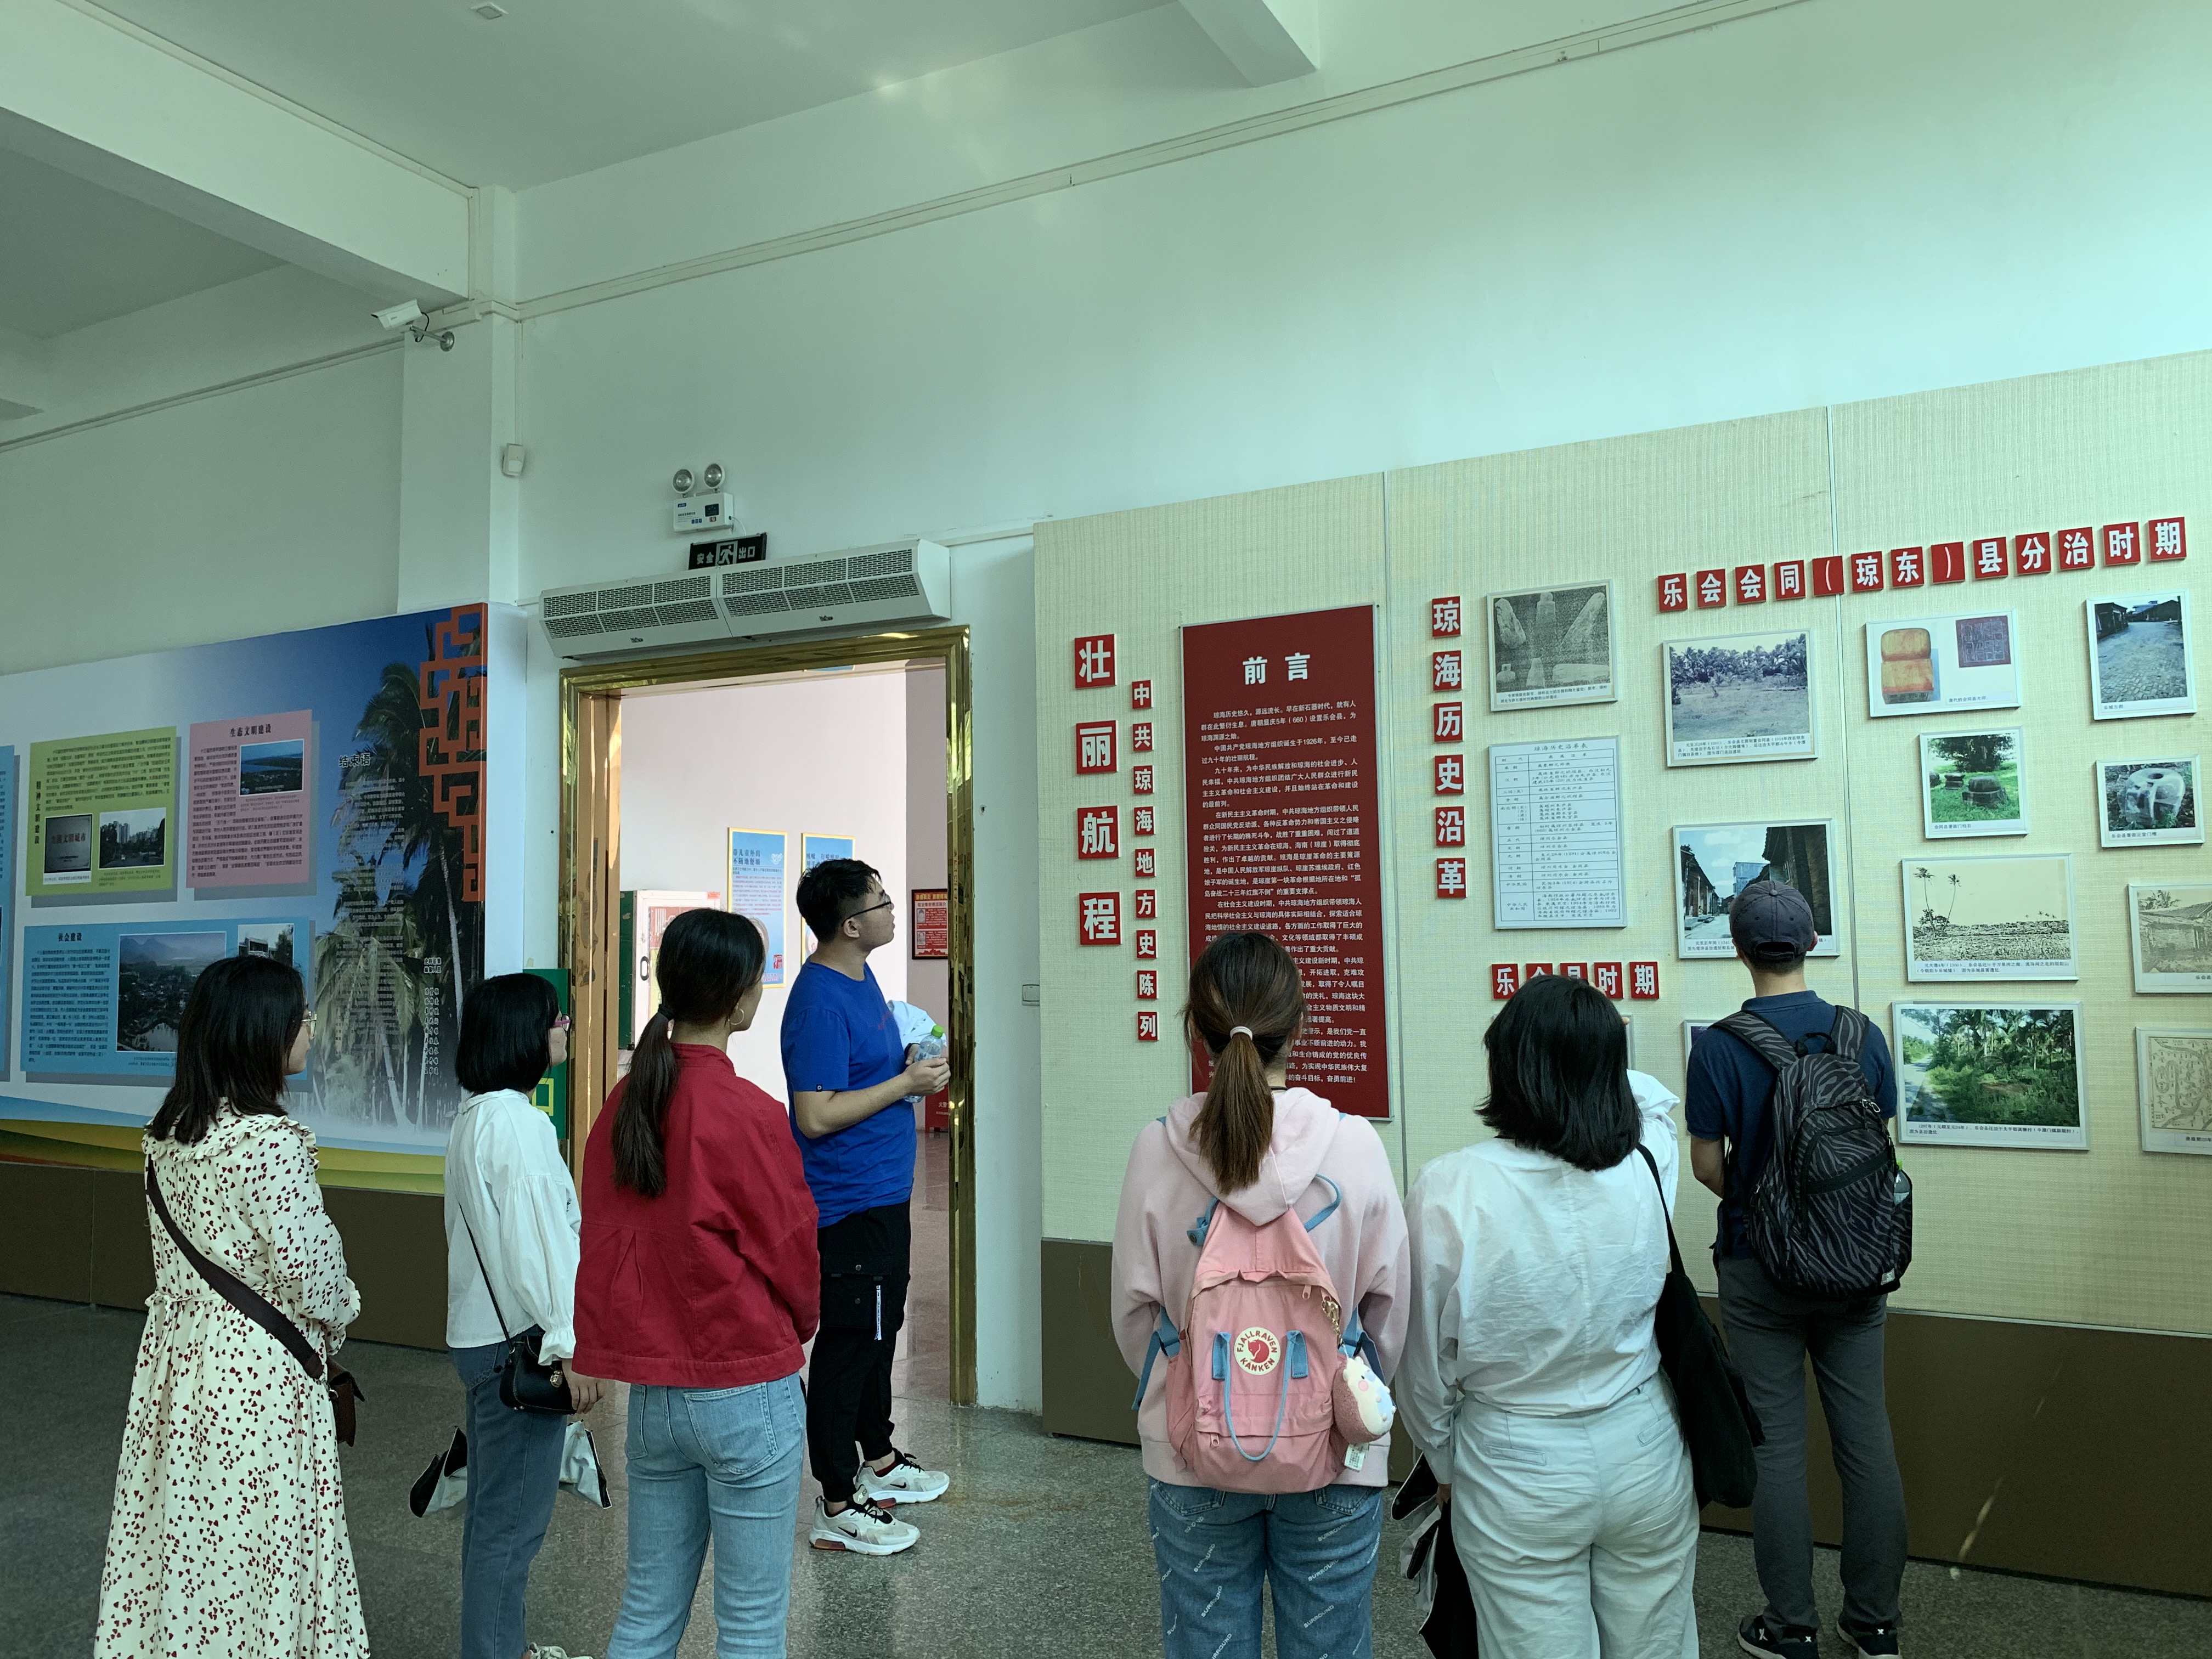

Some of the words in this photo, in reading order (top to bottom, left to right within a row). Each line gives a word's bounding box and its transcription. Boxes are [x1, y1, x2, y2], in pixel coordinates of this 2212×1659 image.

[696, 551, 714, 565] 安全
[738, 546, 755, 560] 出口
[1243, 652, 1311, 685] 前言
[230, 724, 272, 737] 生态文明建设
[1434, 600, 1465, 894] 琼海历史沿革
[338, 753, 371, 768] 结束语
[1079, 640, 1117, 940] 壮丽航程
[1133, 684, 1156, 1037] 中共琼海地方史陈列
[58, 932, 82, 942] 社会建设
[1286, 1062, 1367, 1072] 路，为实现中华民族伟大复
[1304, 1605, 1334, 1628] SURROUND
